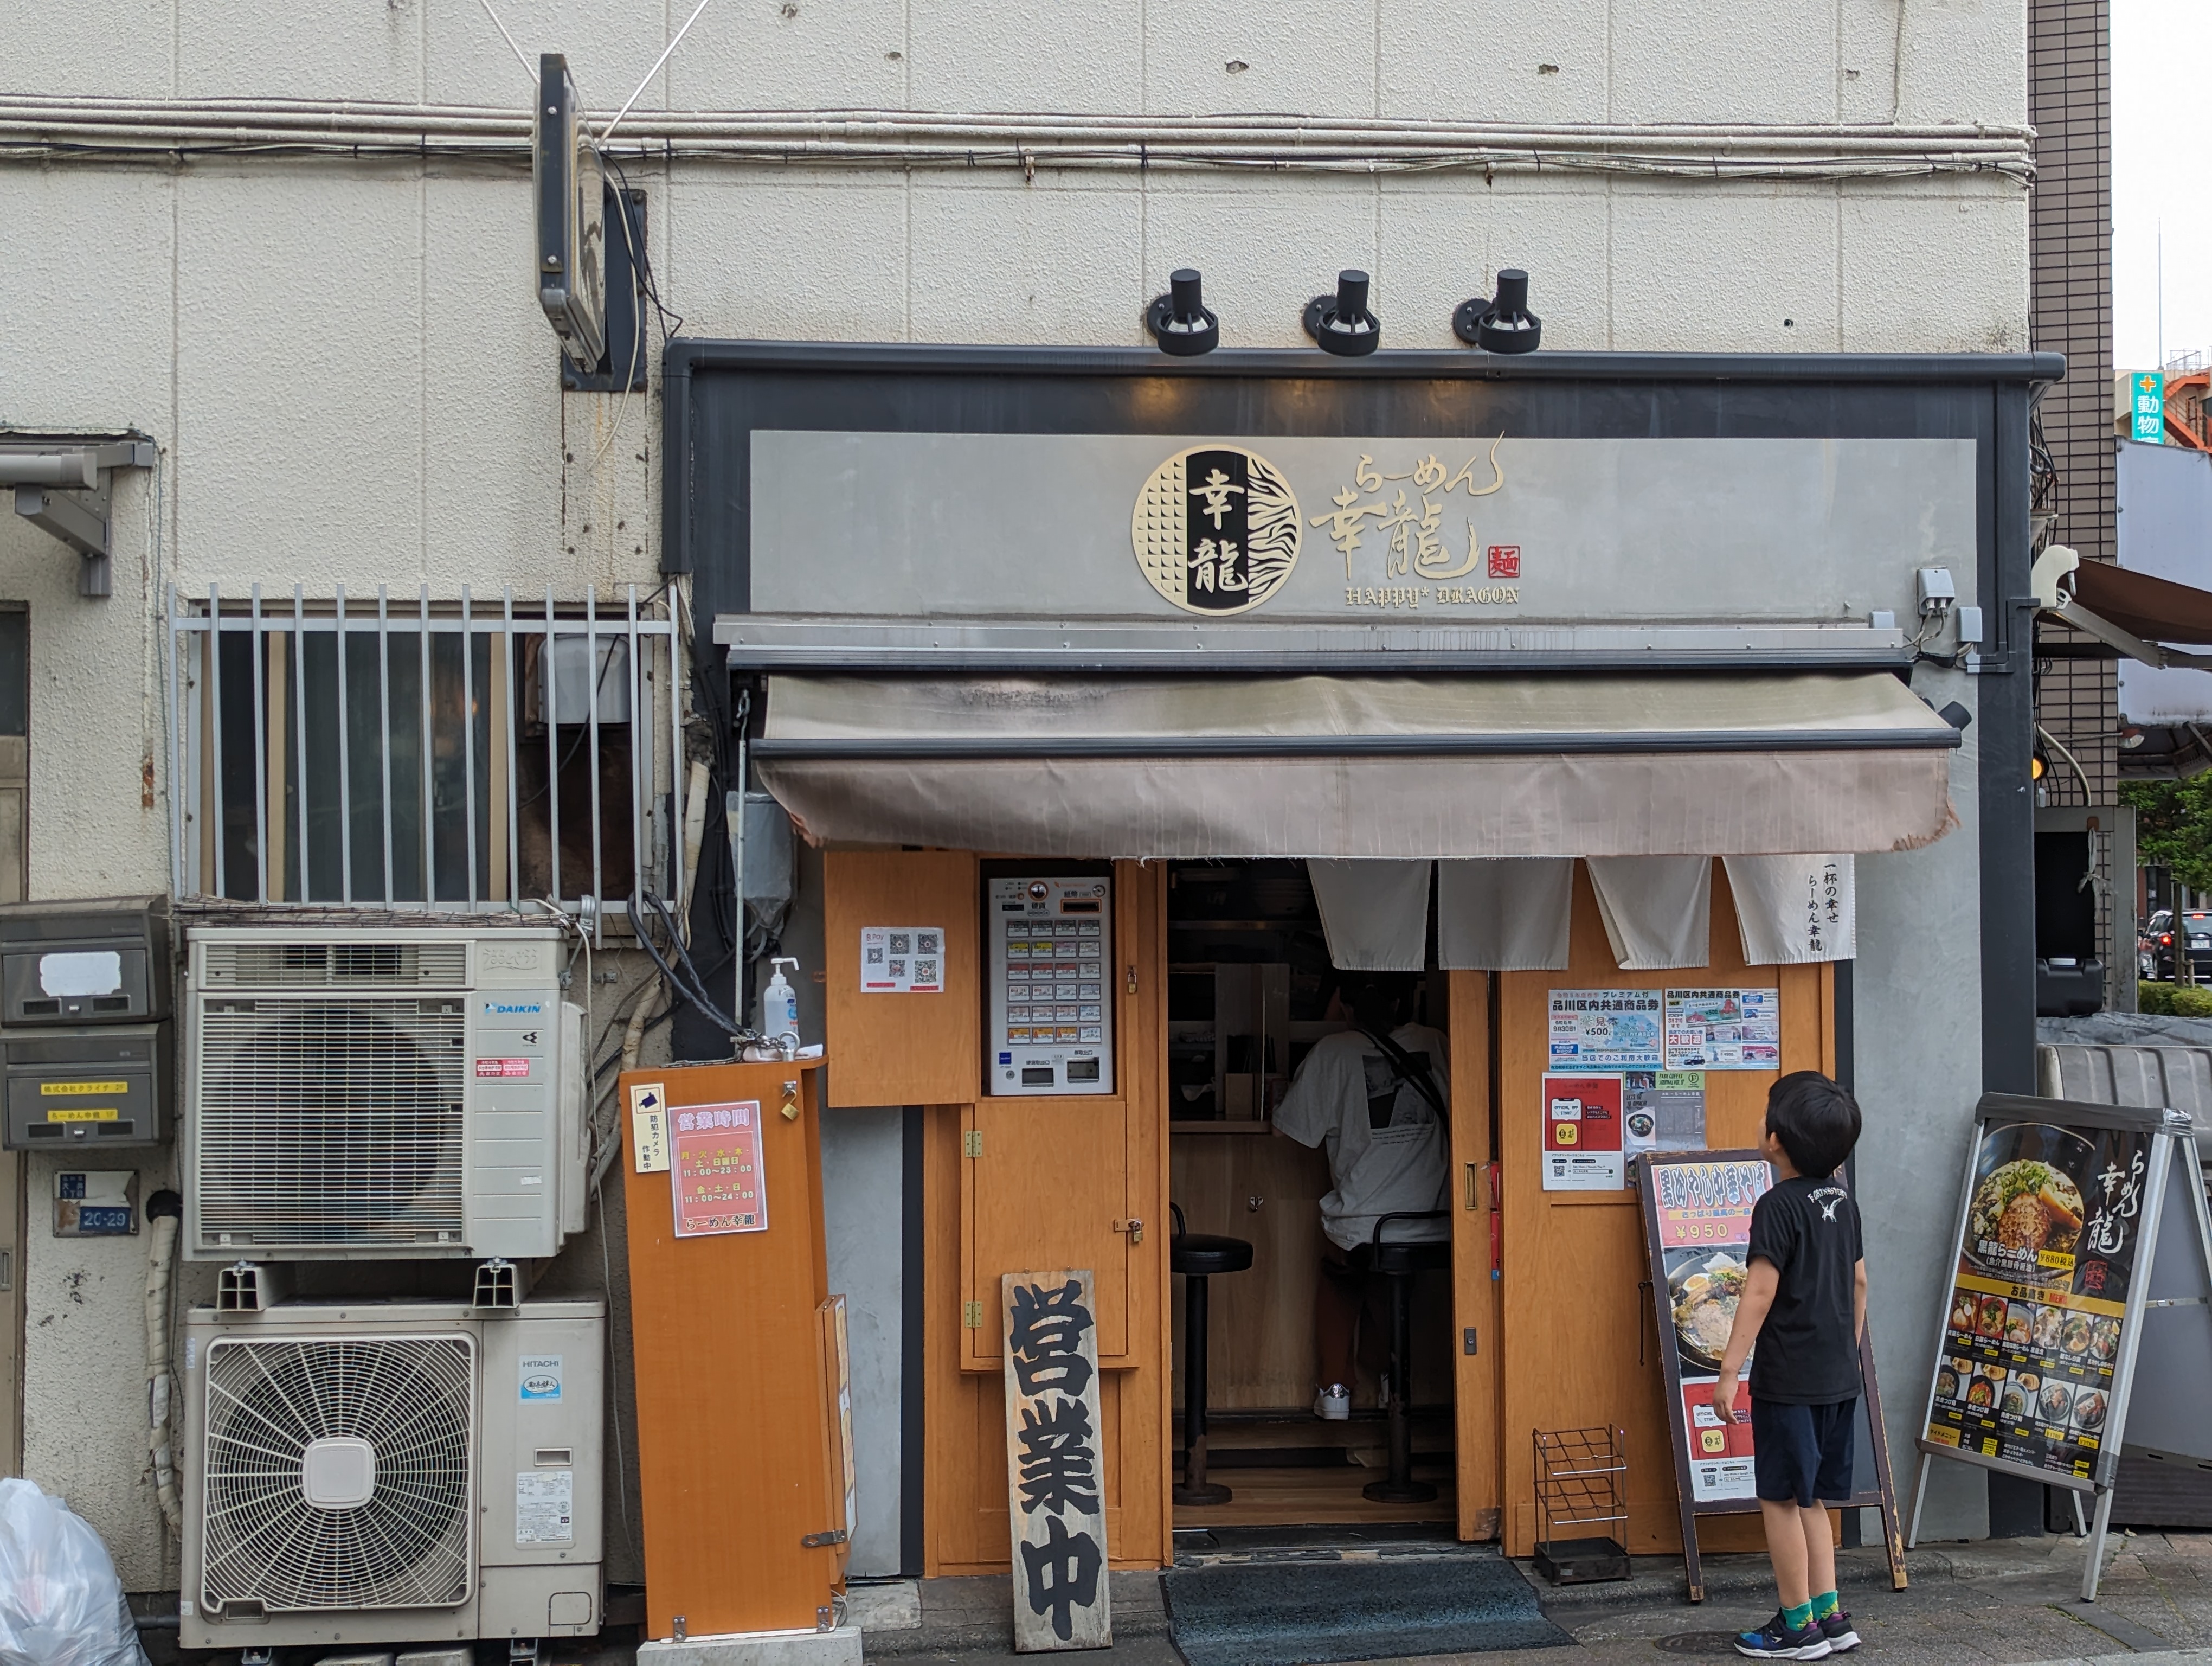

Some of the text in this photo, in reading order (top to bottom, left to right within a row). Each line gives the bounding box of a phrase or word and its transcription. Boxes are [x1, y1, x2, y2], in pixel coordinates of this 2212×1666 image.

[1355, 430, 1506, 496] らーめん
[1188, 469, 1249, 593] 幸龍
[1309, 485, 1481, 580] 幸龍
[1489, 546, 1520, 578] 麺
[1437, 587, 1520, 604] DRAGON
[1823, 863, 1838, 923] 一杯の幸せ
[1807, 875, 1822, 951] らーめん幸龍
[1552, 999, 1660, 1011] 品川区内共通商品券
[1667, 990, 1740, 999] 品川区内共通商品券
[678, 1108, 750, 1131] 営業時間
[650, 1115, 660, 1156] 防犯カメラ
[642, 1145, 652, 1170] 作動中
[697, 1182, 741, 1194] 金・土・日
[2113, 1150, 2145, 1218] らーめん
[84, 1212, 126, 1227] 20-29
[2087, 1161, 2125, 1254] 幸龍
[686, 1214, 755, 1230] らーめん幸龍
[1675, 1223, 1728, 1240] ¥950
[1977, 1239, 2038, 1263] 黒龍らーめん
[2011, 1285, 2045, 1301] お品書き
[1010, 1279, 1102, 1641] 営業中
